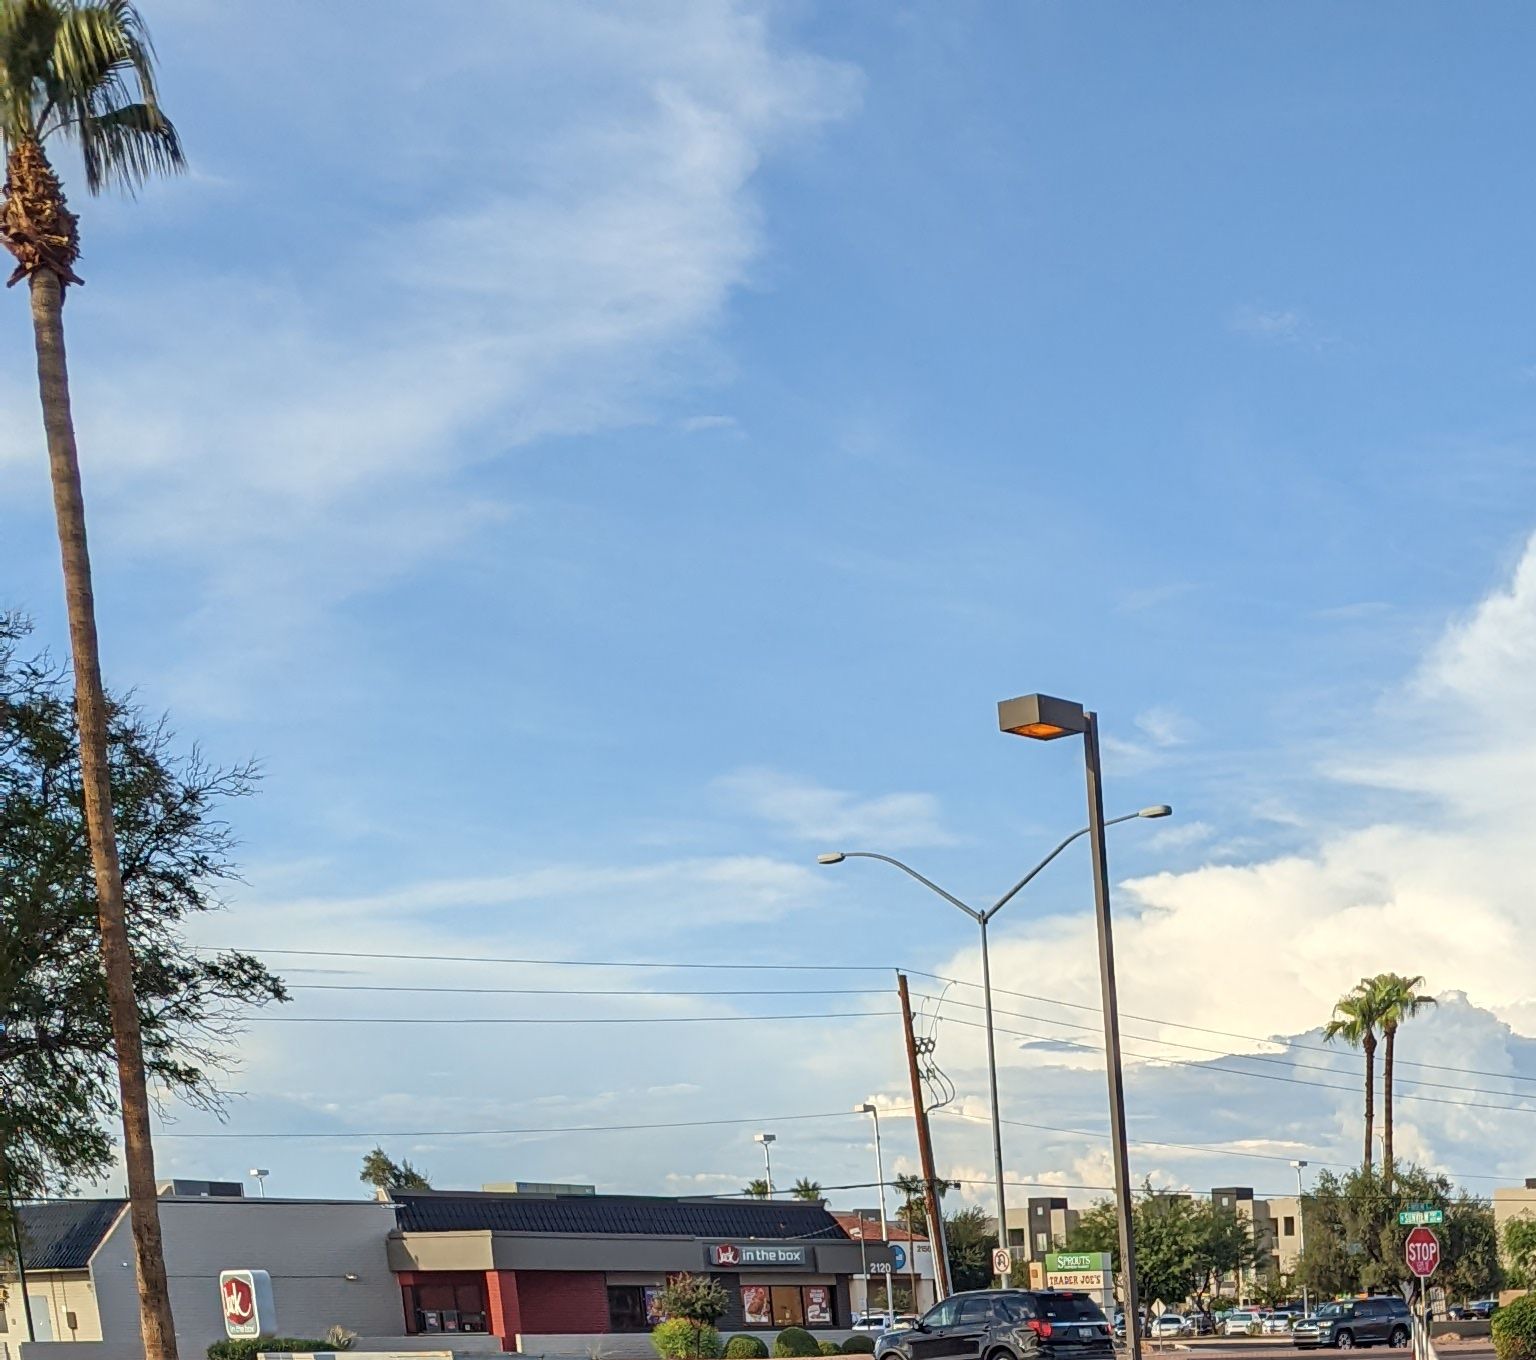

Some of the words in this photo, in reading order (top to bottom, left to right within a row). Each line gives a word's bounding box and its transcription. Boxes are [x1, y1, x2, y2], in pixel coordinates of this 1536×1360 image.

[742, 1249, 755, 1261] in
[756, 1249, 777, 1261] the
[778, 1248, 801, 1261] box
[1409, 1242, 1436, 1261] STOP
[870, 1262, 892, 1273] 2120
[1049, 1275, 1078, 1285] TRADER
[1080, 1274, 1101, 1285] JOE'S
